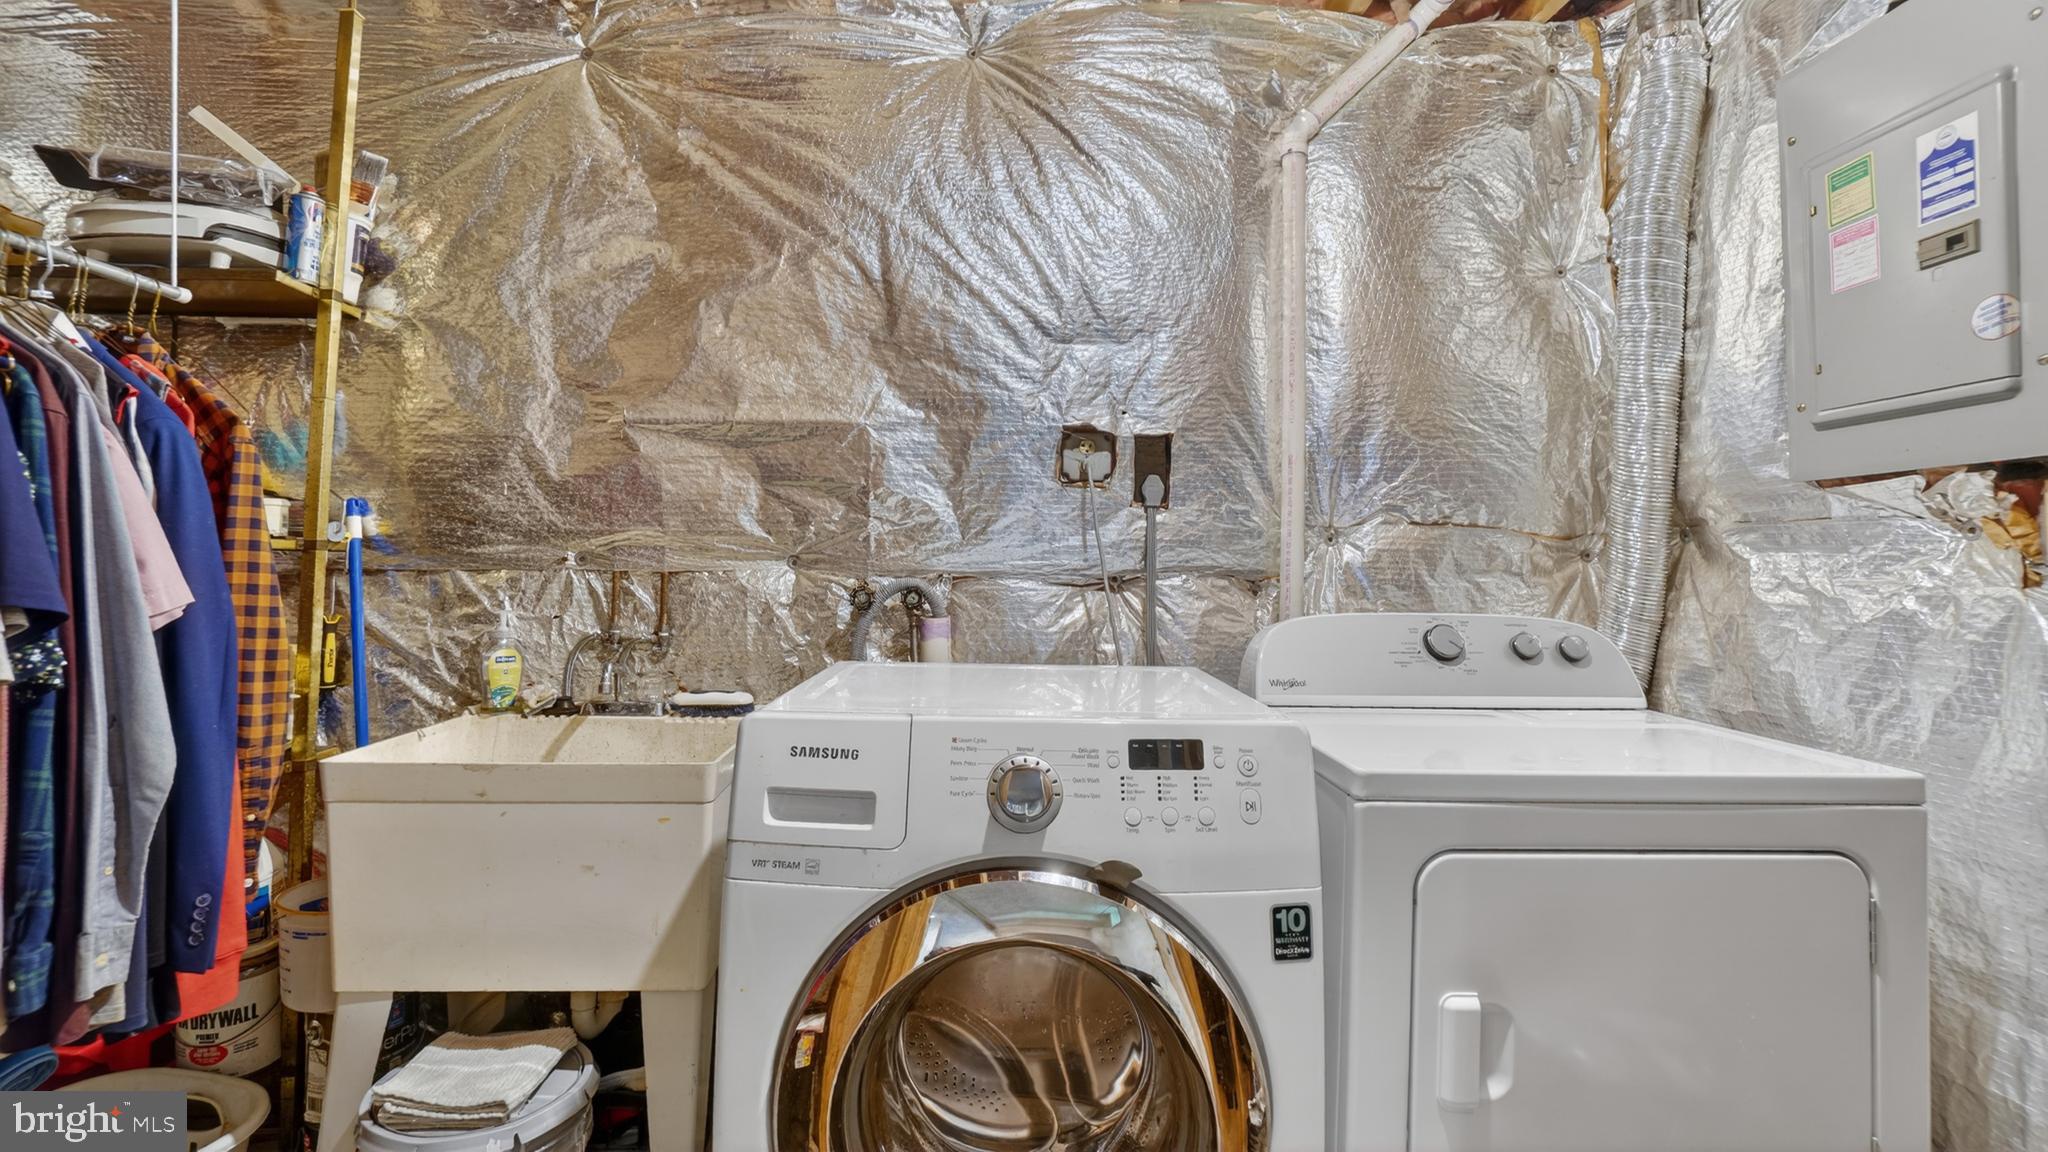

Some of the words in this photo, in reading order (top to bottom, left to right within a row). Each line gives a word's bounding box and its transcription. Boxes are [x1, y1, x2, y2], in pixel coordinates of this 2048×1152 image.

[790, 745, 860, 761] SAMSUNG
[771, 860, 801, 870] STEAM
[1275, 907, 1306, 933] 10
[190, 1002, 260, 1030] DRYWALL
